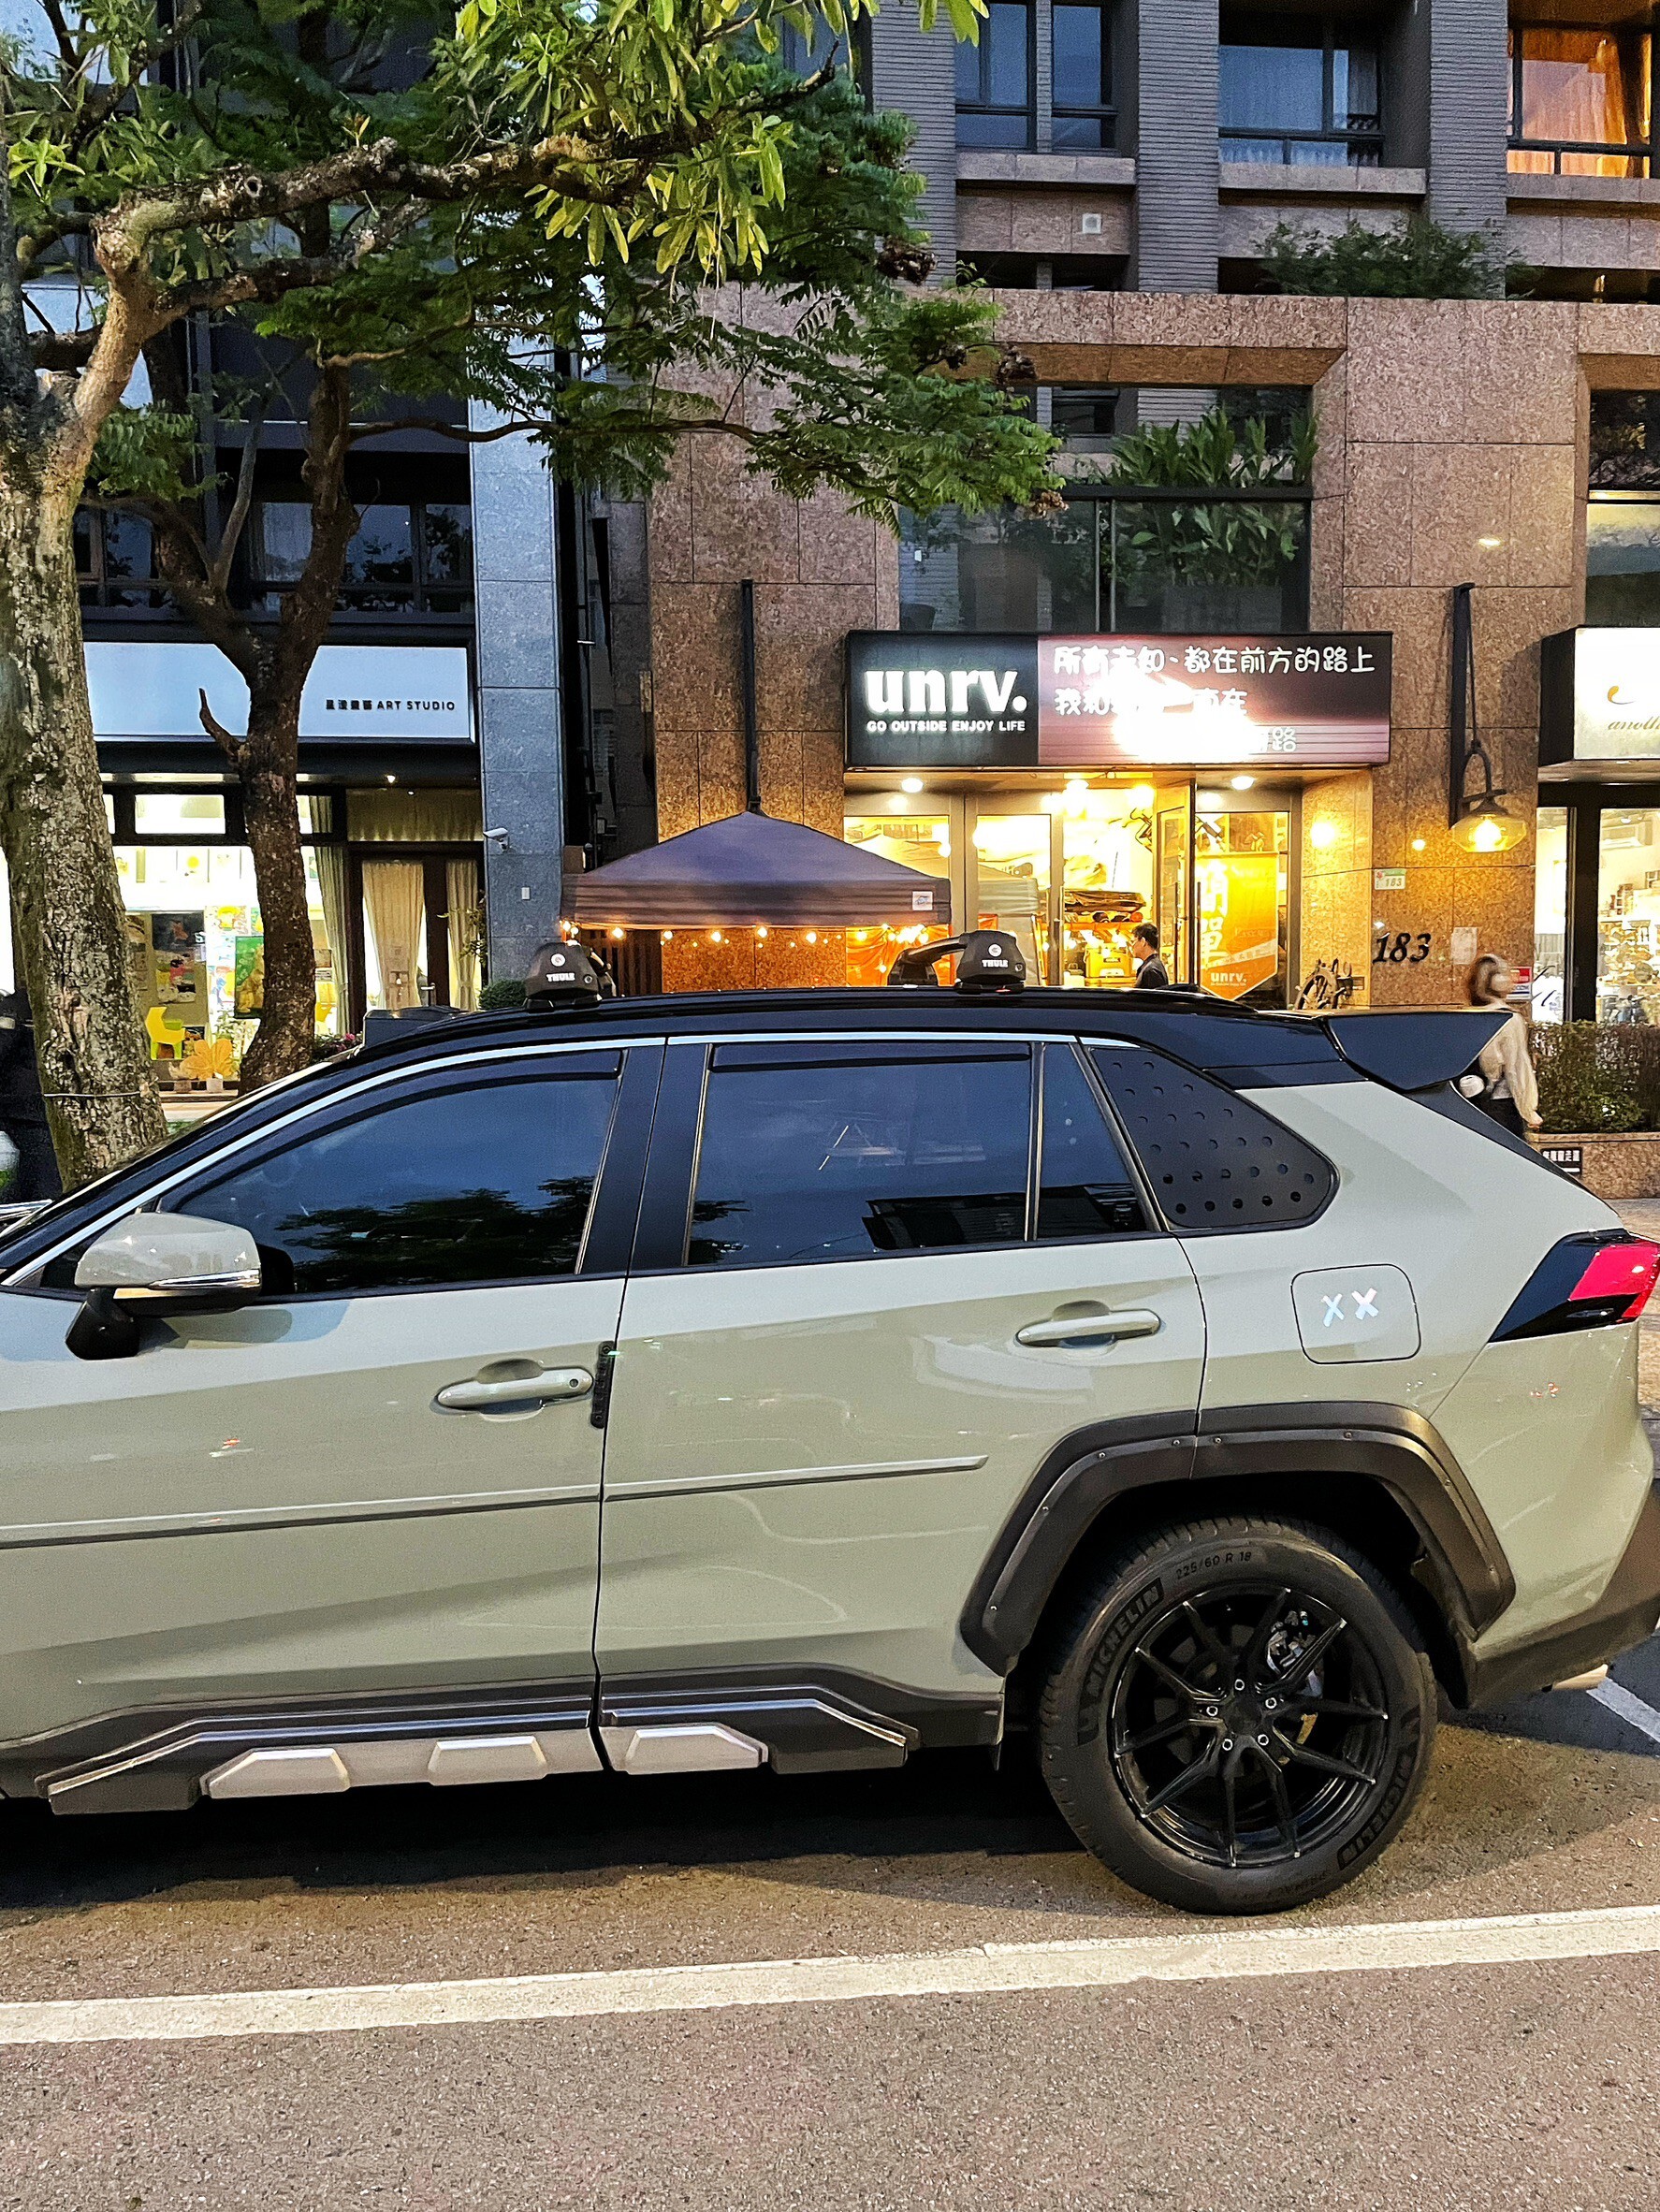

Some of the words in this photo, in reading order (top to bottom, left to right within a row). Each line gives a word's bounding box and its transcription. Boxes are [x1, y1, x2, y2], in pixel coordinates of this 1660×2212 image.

[866, 669, 1027, 714] unrv.
[377, 700, 401, 710] ART
[407, 701, 456, 711] STUDIO
[866, 720, 887, 733] GO
[892, 720, 947, 733] OUTSIDE
[952, 720, 995, 733] ENJOY
[998, 720, 1026, 733] LIFE
[1372, 932, 1432, 965] 183
[982, 959, 1009, 968] THULE
[546, 972, 575, 982] THULE
[1210, 972, 1247, 982] unrv.
[1176, 1554, 1220, 1579] 225/60
[1225, 1552, 1234, 1564] R
[1239, 1551, 1252, 1562] 18
[1085, 1584, 1160, 1698] MICHELIN
